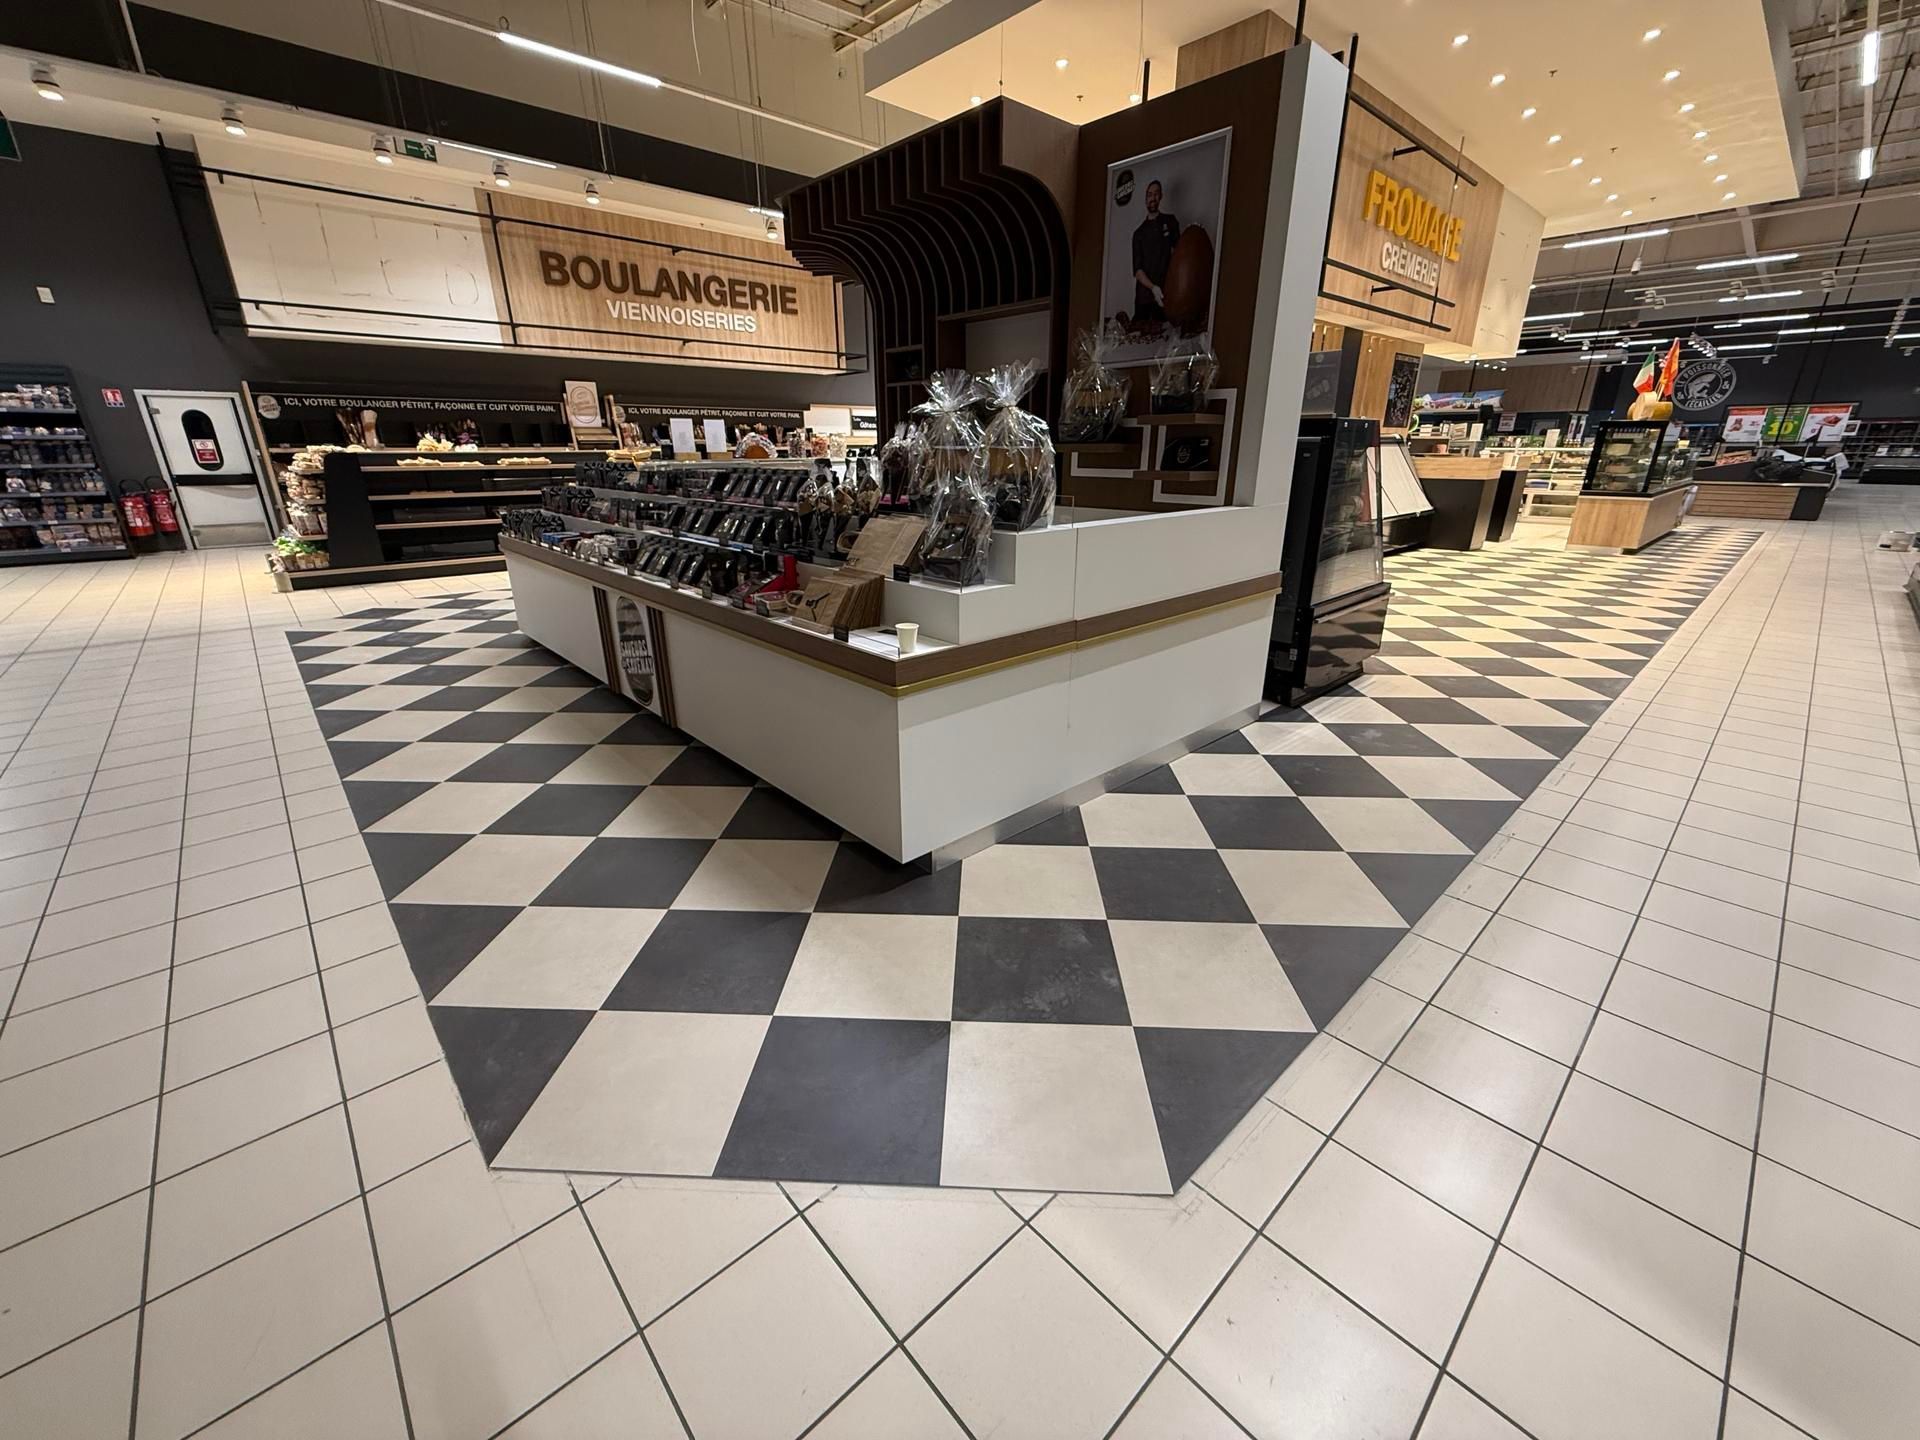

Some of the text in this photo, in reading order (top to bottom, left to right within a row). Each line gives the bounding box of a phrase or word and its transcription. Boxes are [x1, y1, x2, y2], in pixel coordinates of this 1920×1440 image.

[1363, 169, 1466, 262] FROMAGE
[539, 250, 799, 315] BOULANGERIE
[1381, 242, 1440, 287] CRÈMERIE
[606, 299, 758, 333] VIENNOISERIES
[284, 397, 301, 408] ICI,
[303, 397, 337, 407] VOTRE
[340, 399, 398, 409] BOULANGER
[400, 400, 434, 410] PÉTRIT,
[435, 401, 475, 412] FAÇONNE
[489, 403, 508, 411] CUIT
[509, 404, 535, 412] VOTRE
[537, 404, 556, 413] PAIN.
[640, 407, 661, 415] VOTRE
[662, 408, 699, 416] BOULANGER
[700, 409, 721, 417] PÉTRIT,
[722, 410, 749, 418] FAÇONNE
